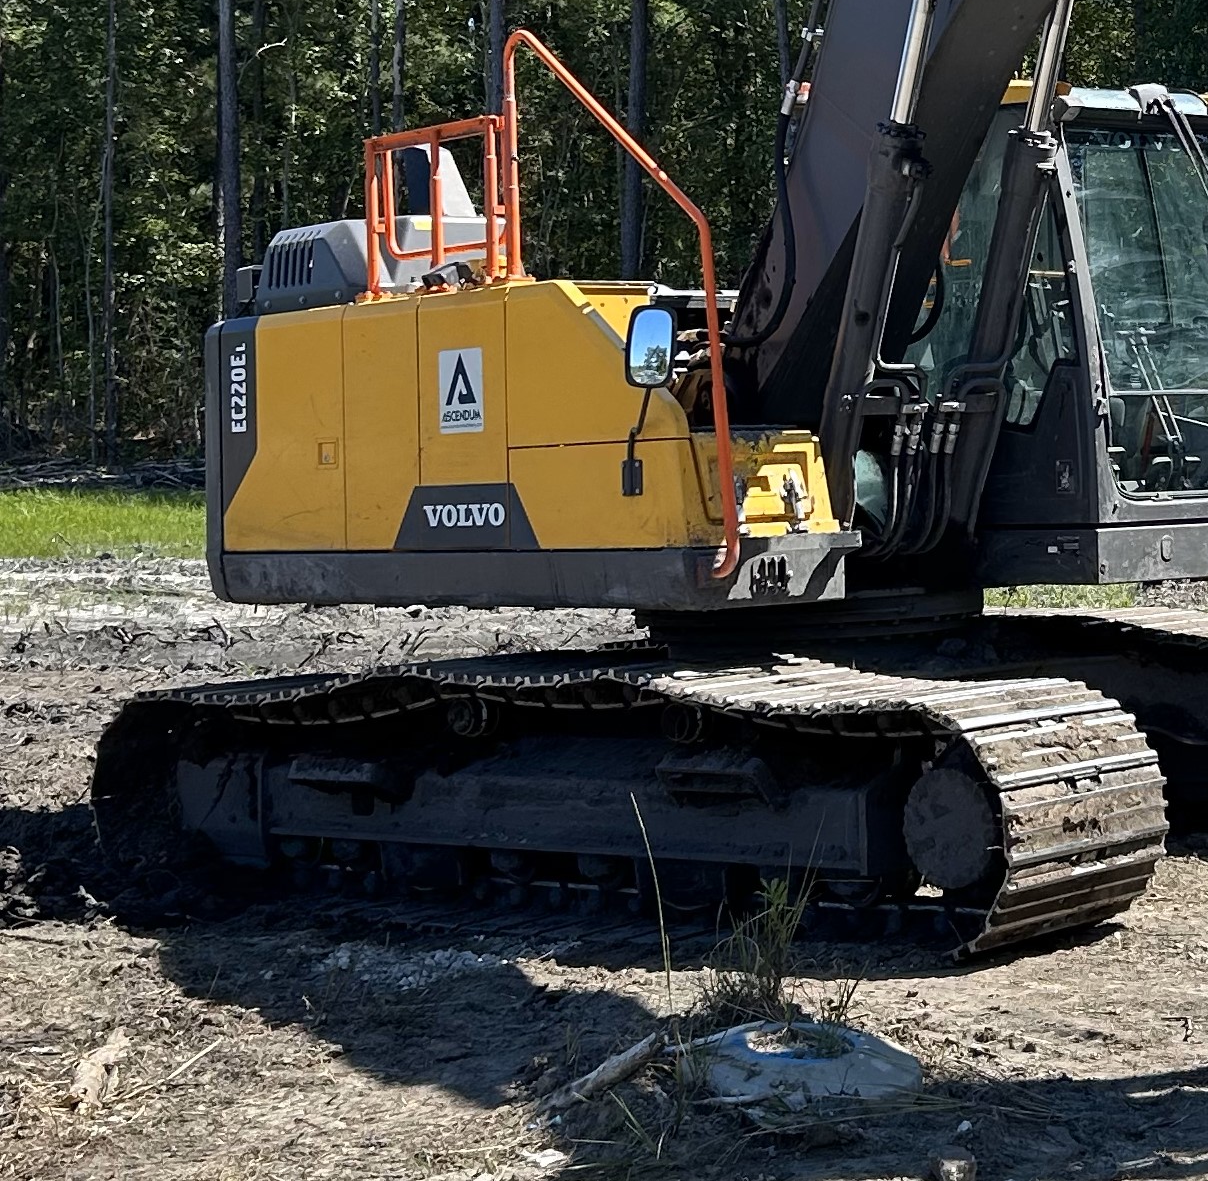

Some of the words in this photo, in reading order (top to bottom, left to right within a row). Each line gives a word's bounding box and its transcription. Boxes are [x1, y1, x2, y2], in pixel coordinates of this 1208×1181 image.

[230, 342, 247, 433] EC220EL
[442, 408, 482, 422] ASCENDUM
[423, 503, 505, 527] VOLVO
